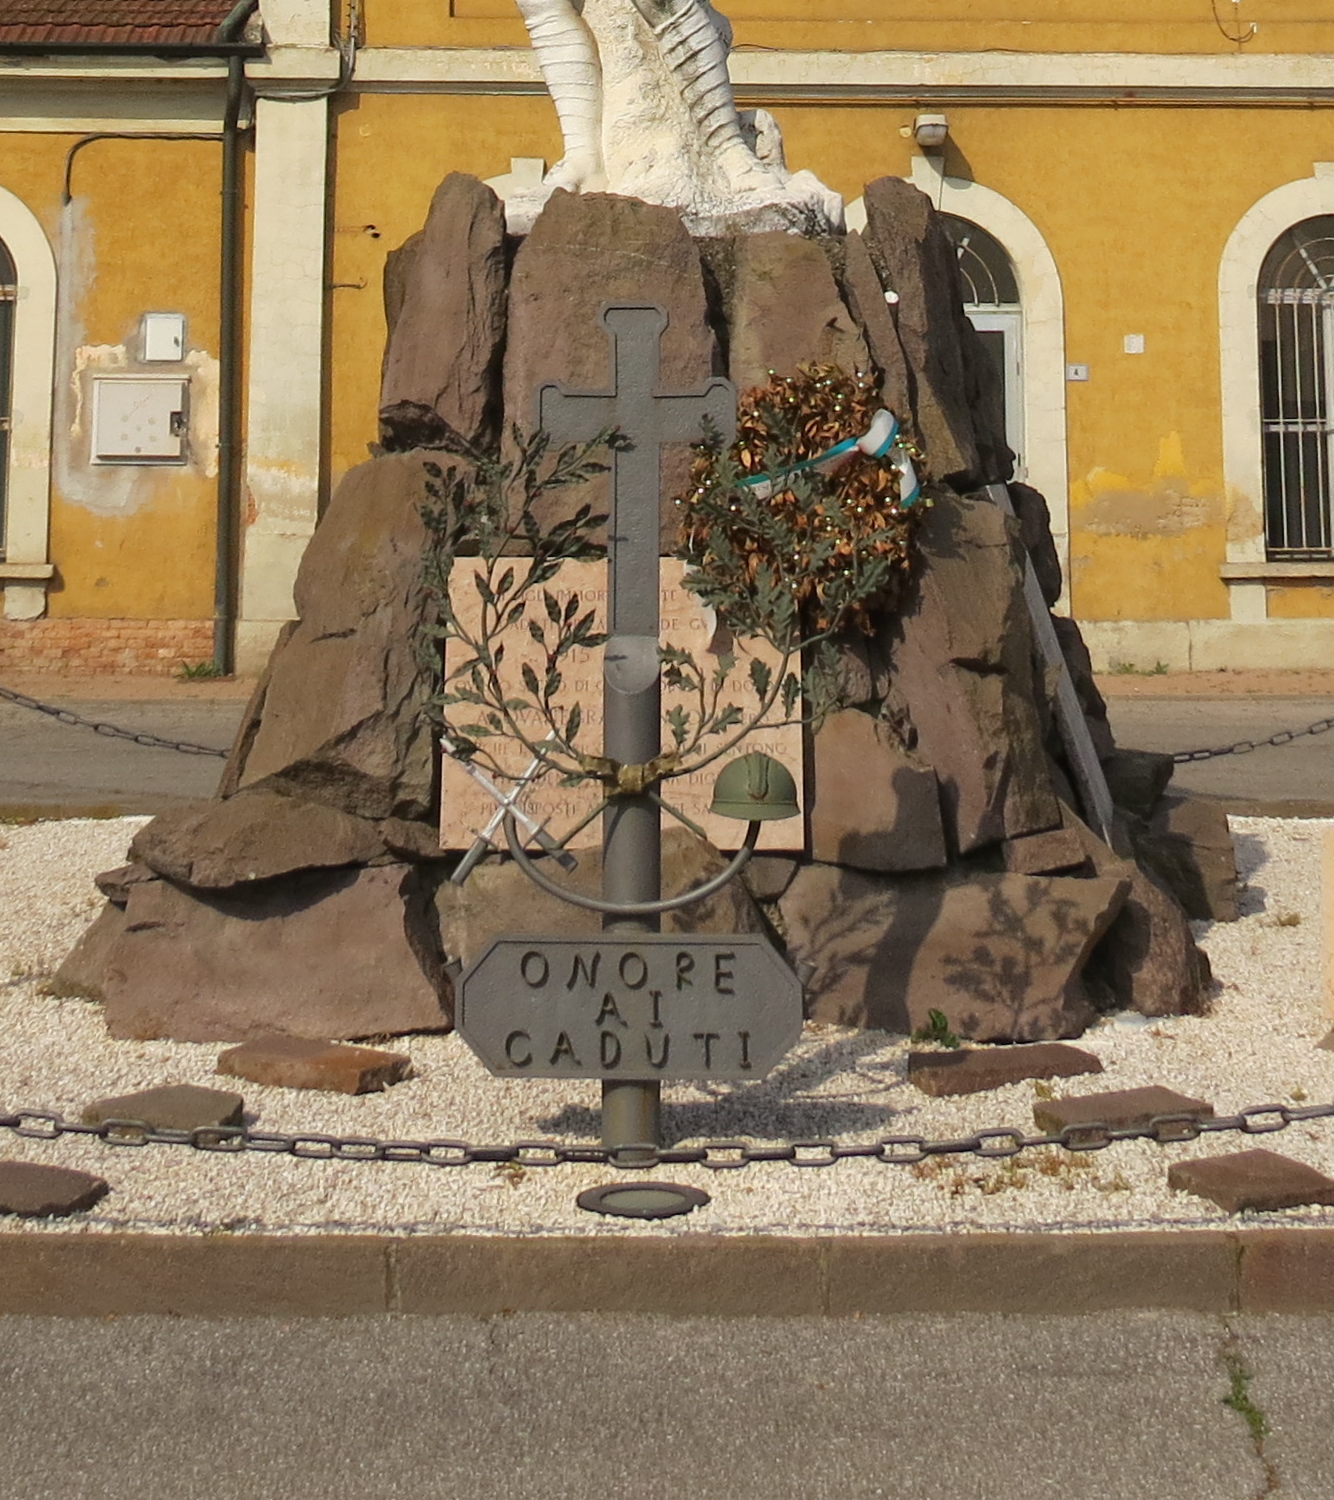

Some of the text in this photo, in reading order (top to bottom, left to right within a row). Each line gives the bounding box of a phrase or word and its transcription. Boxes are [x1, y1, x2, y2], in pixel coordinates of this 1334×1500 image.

[520, 950, 737, 996] ONORE
[595, 990, 664, 1029] AI
[504, 1030, 753, 1071] CADUTI
